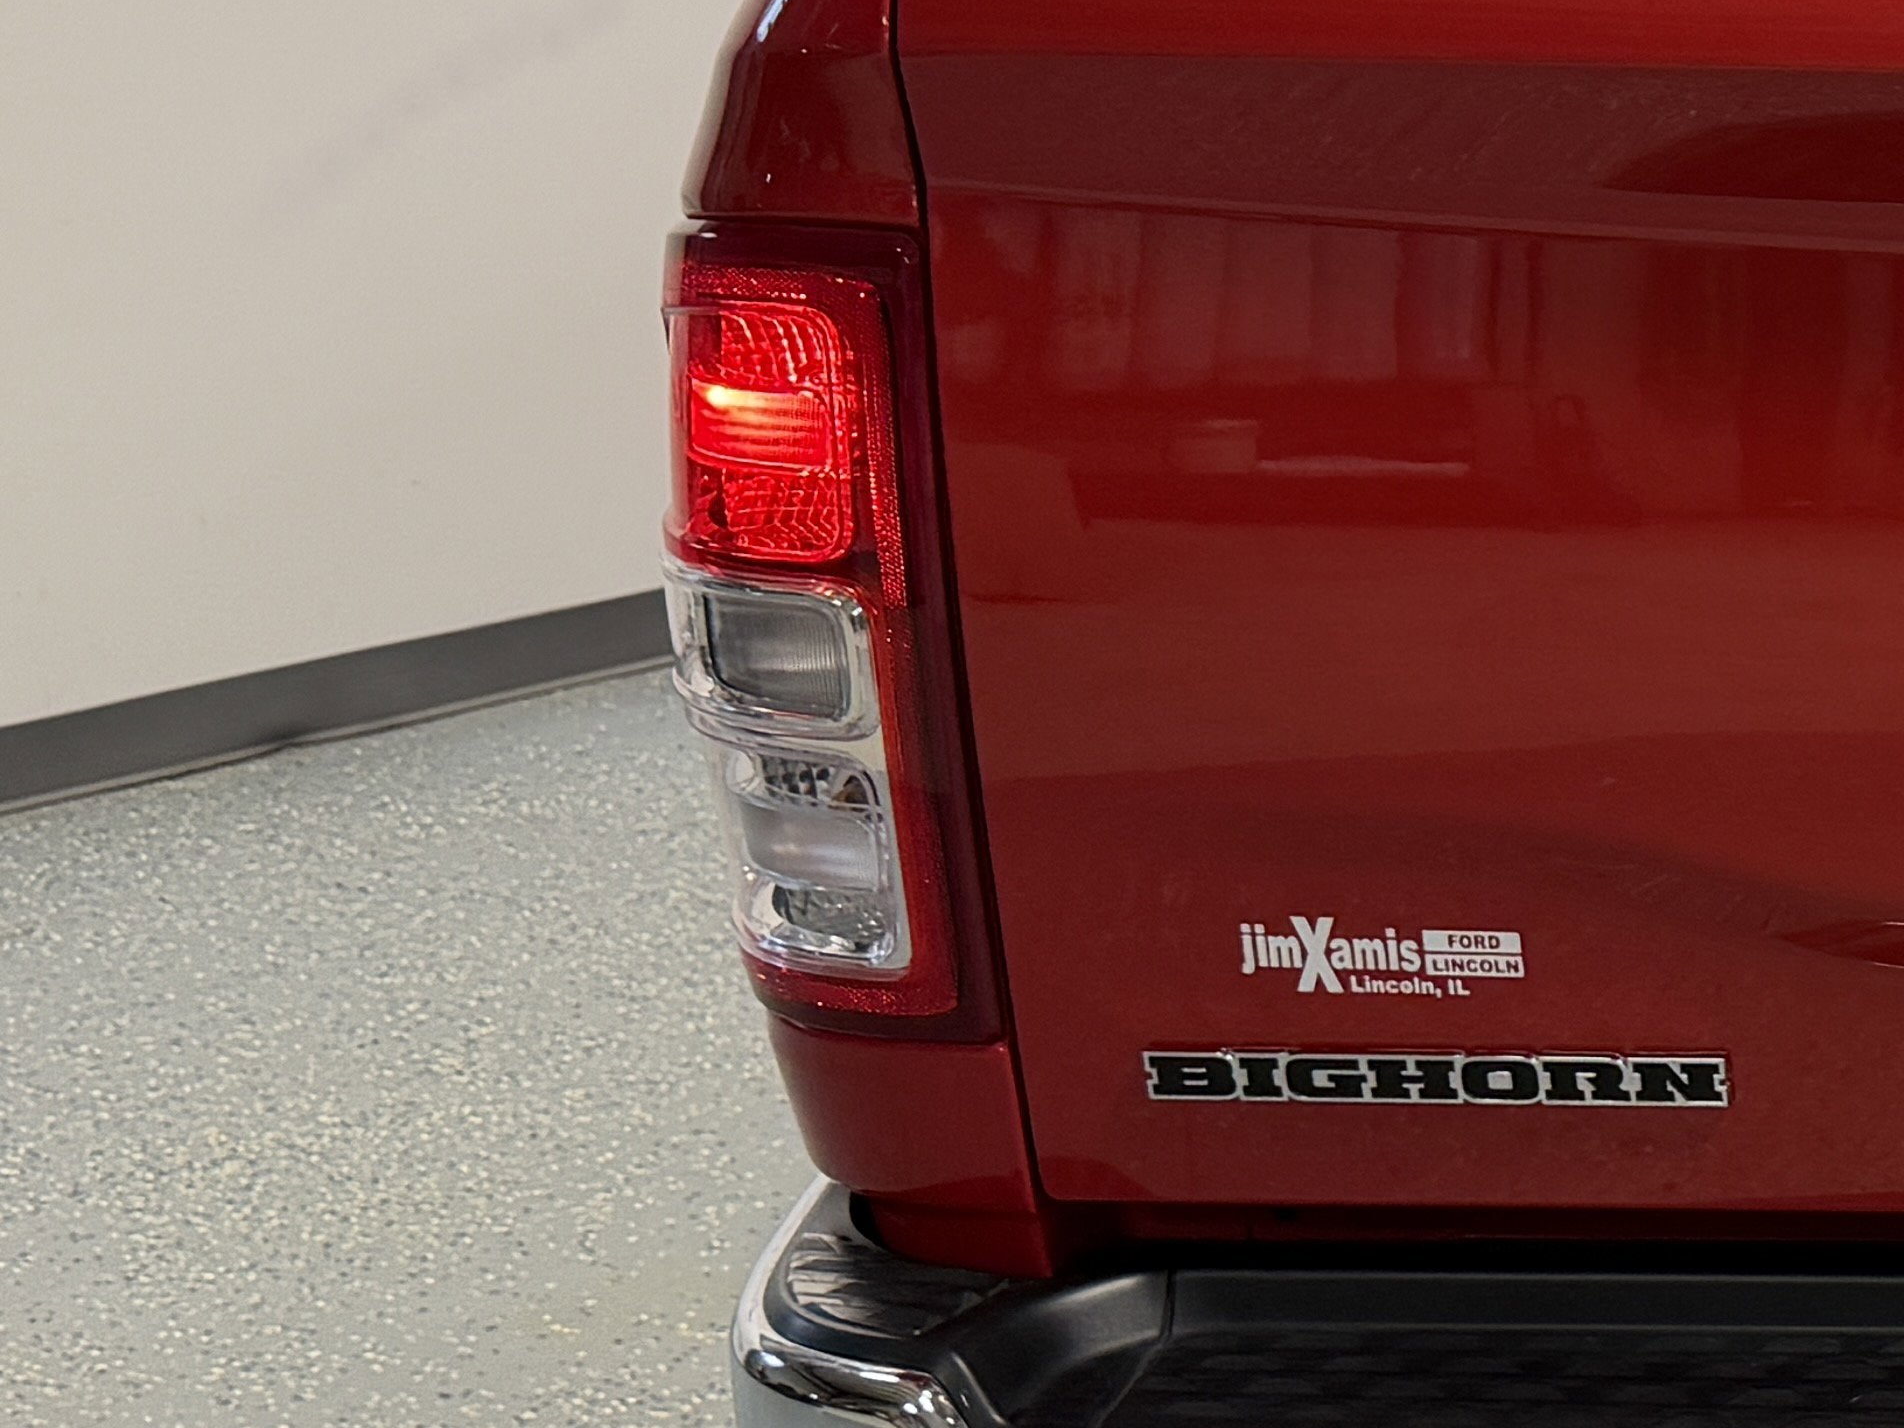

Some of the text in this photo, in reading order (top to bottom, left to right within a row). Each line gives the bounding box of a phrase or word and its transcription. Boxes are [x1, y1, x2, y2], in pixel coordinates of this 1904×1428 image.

[1446, 933, 1501, 950] FORD
[1431, 957, 1520, 974] LINCOLN
[1350, 974, 1471, 999] Lincoln, IL
[1143, 1049, 1729, 1107] BIGHORN
